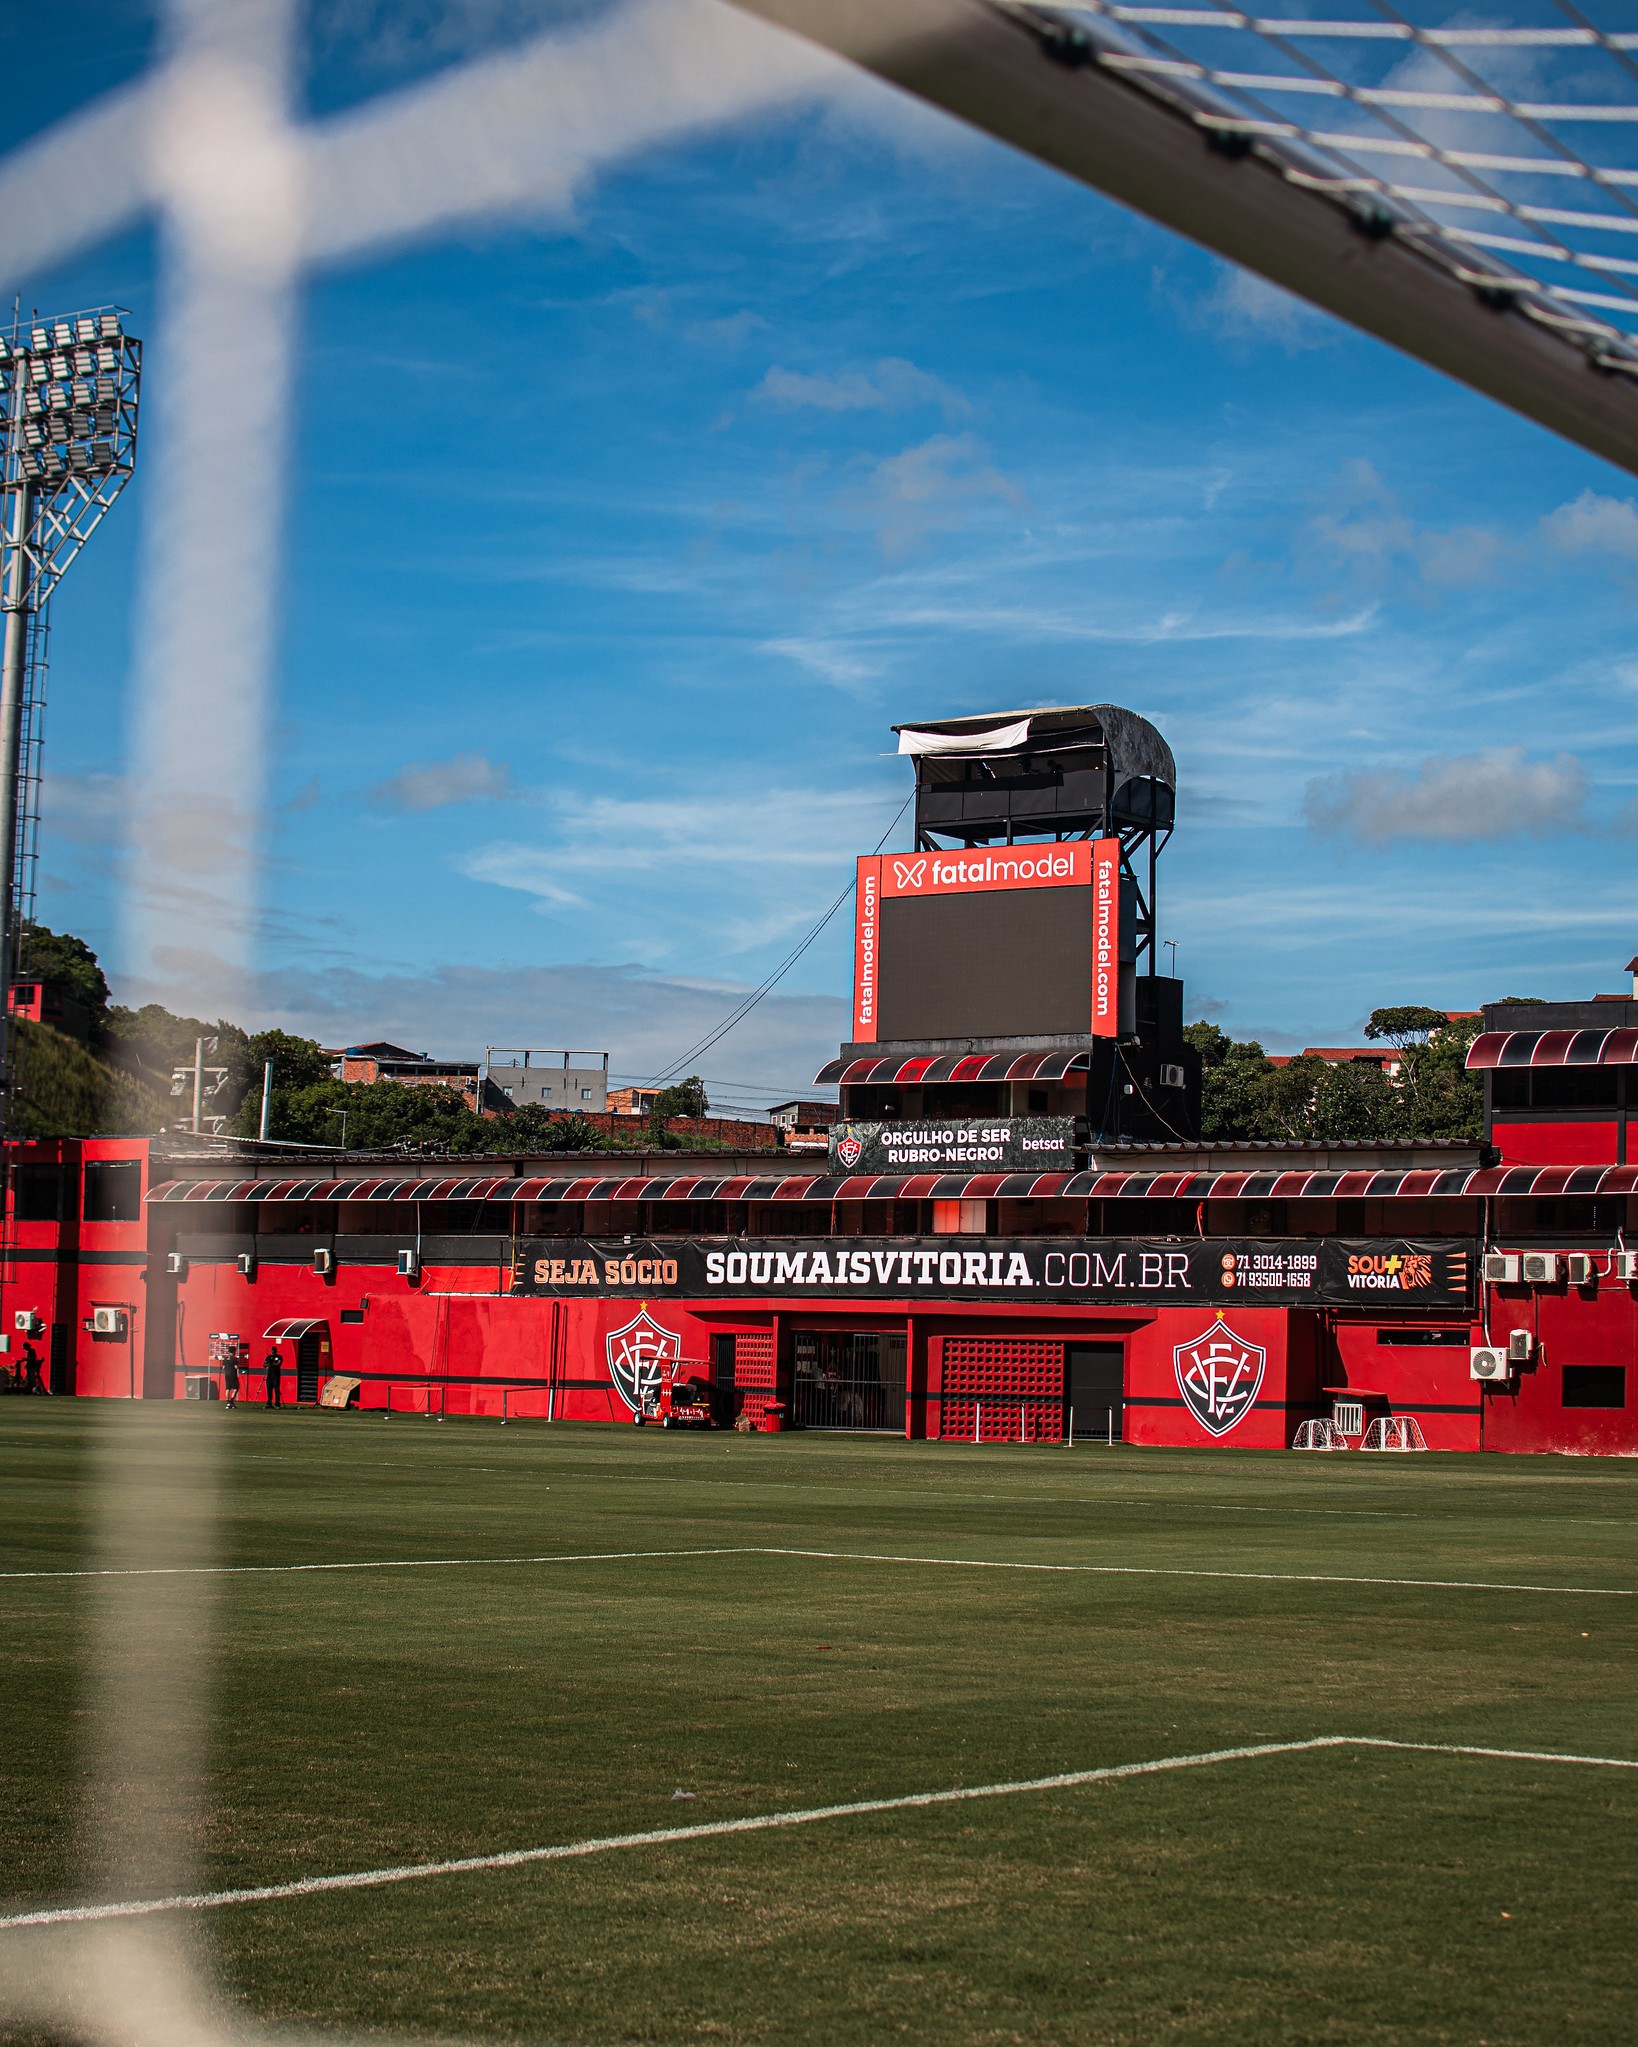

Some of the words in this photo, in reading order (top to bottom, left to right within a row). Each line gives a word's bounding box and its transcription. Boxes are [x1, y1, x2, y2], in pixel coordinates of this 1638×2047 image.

[931, 851, 1075, 885] fatalmodel
[1096, 859, 1113, 1017] fatalmodel.com
[859, 875, 876, 1025] fatalmodel.com
[881, 1129, 954, 1146] ORGULHO
[956, 1129, 979, 1145] DE
[981, 1128, 1011, 1143] SER
[1022, 1138, 1065, 1151] betsat
[888, 1146, 1004, 1163] RUBRO-NEGRO!
[534, 1259, 600, 1285] SEJA
[605, 1253, 679, 1286] SÓCIO
[705, 1251, 1192, 1289] SOUMAISVITORIA.COM.BR
[1236, 1255, 1250, 1270] 71
[1253, 1255, 1317, 1270] 3014-1899
[1236, 1272, 1247, 1287] 71
[1248, 1272, 1311, 1288] 93500-1658
[1347, 1271, 1400, 1289] VITÓRIA
